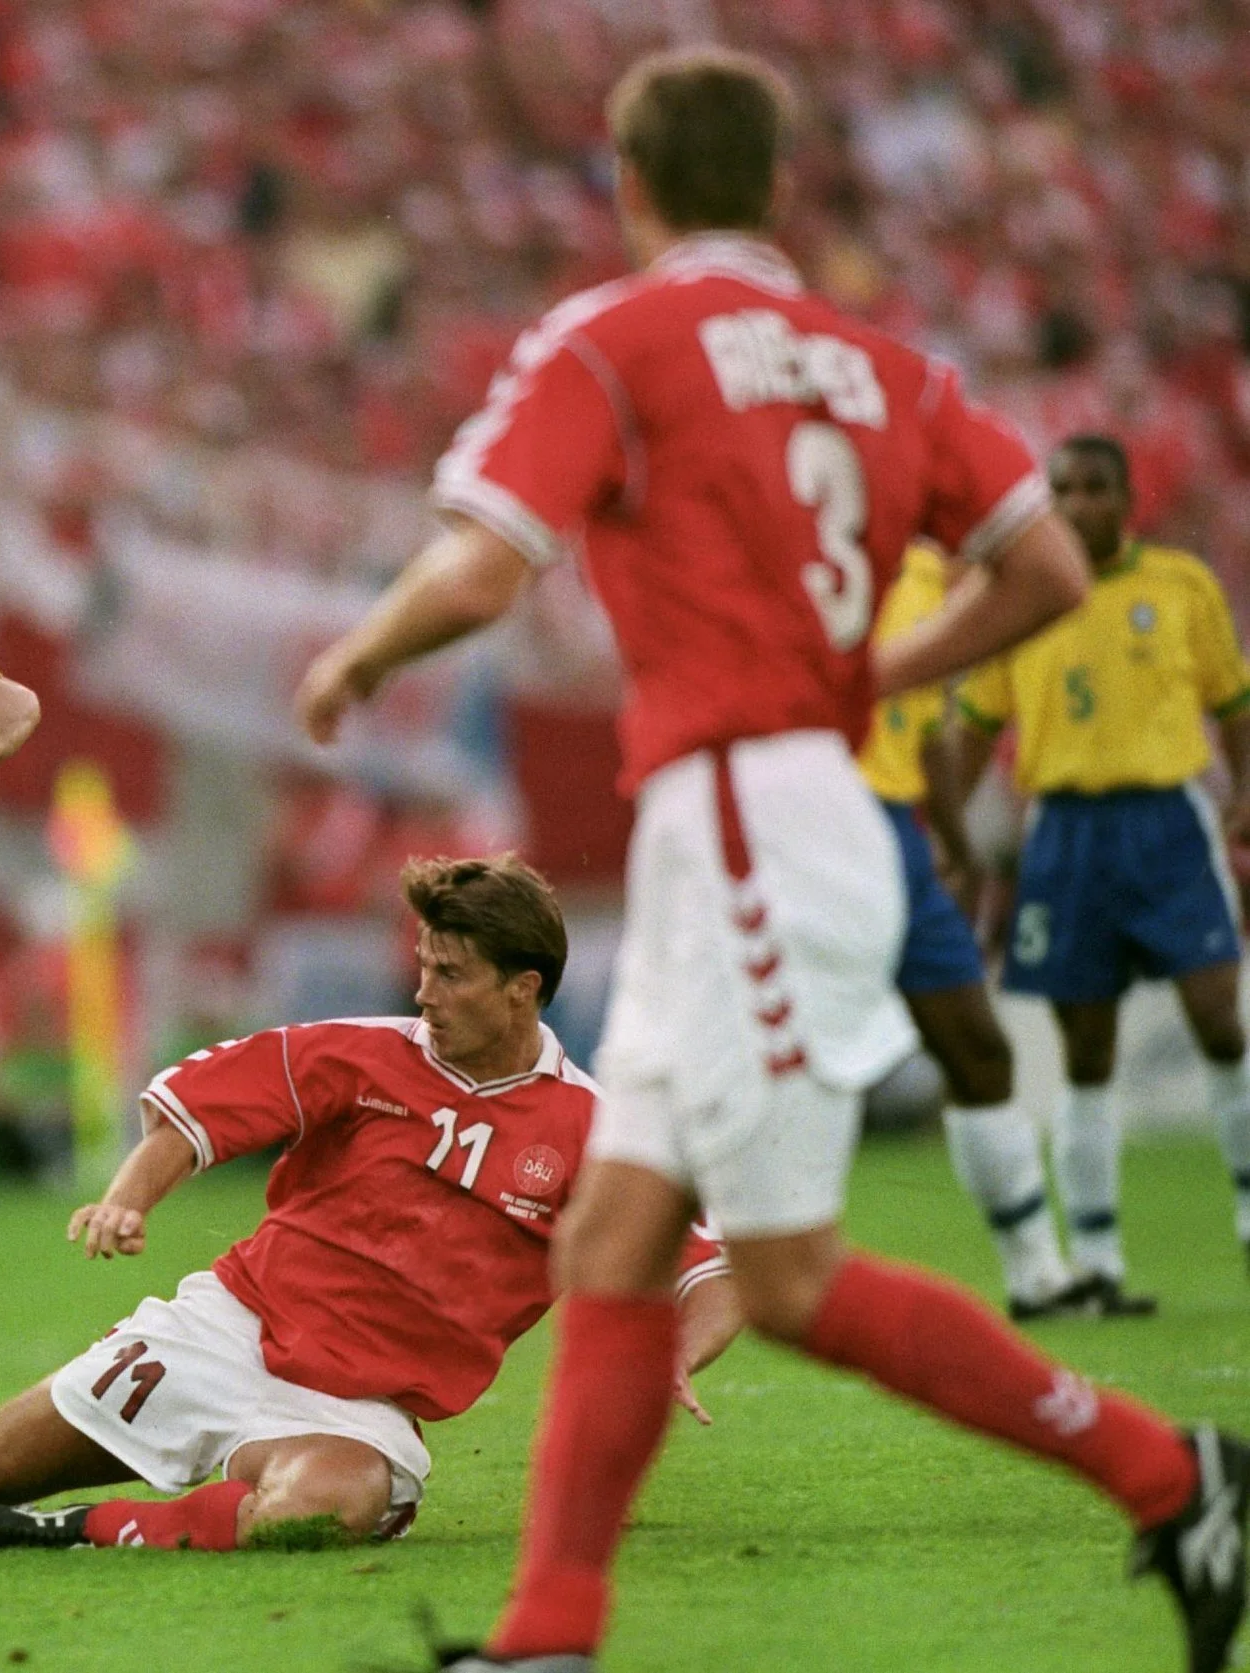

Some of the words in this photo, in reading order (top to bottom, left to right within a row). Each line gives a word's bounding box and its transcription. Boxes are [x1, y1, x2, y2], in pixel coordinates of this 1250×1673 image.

[786, 421, 874, 652] 3
[1065, 666, 1096, 724] 5
[356, 1095, 409, 1117] ummel
[425, 1106, 494, 1191] 11
[523, 1158, 554, 1182] DBU
[91, 1340, 167, 1425] 11
